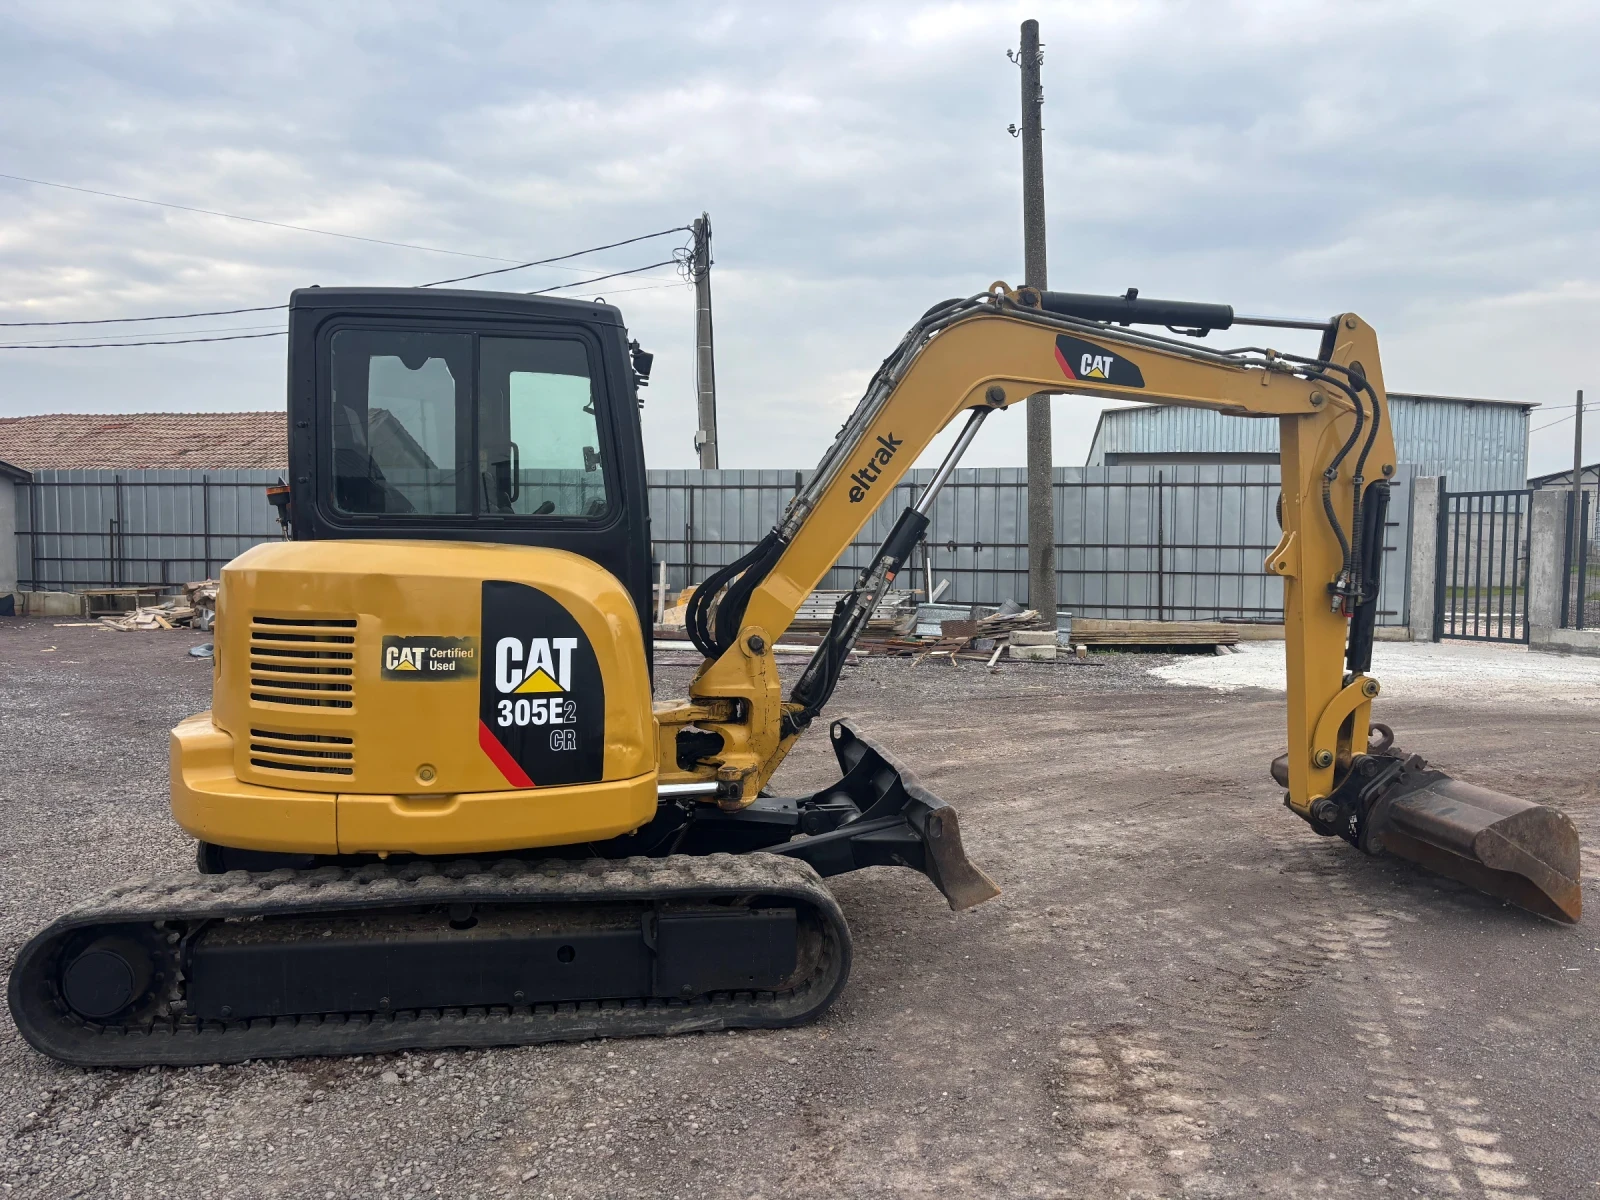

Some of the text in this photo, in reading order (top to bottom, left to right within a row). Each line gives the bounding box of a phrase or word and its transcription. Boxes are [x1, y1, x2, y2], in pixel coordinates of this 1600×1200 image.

[1080, 353, 1114, 379] CAT
[848, 431, 904, 504] eltrak
[385, 646, 426, 671] CAT
[429, 647, 474, 658] Certified
[495, 636, 578, 694] CAT
[429, 660, 456, 671] Used
[497, 697, 577, 727] 305E2
[549, 729, 577, 752] CR
